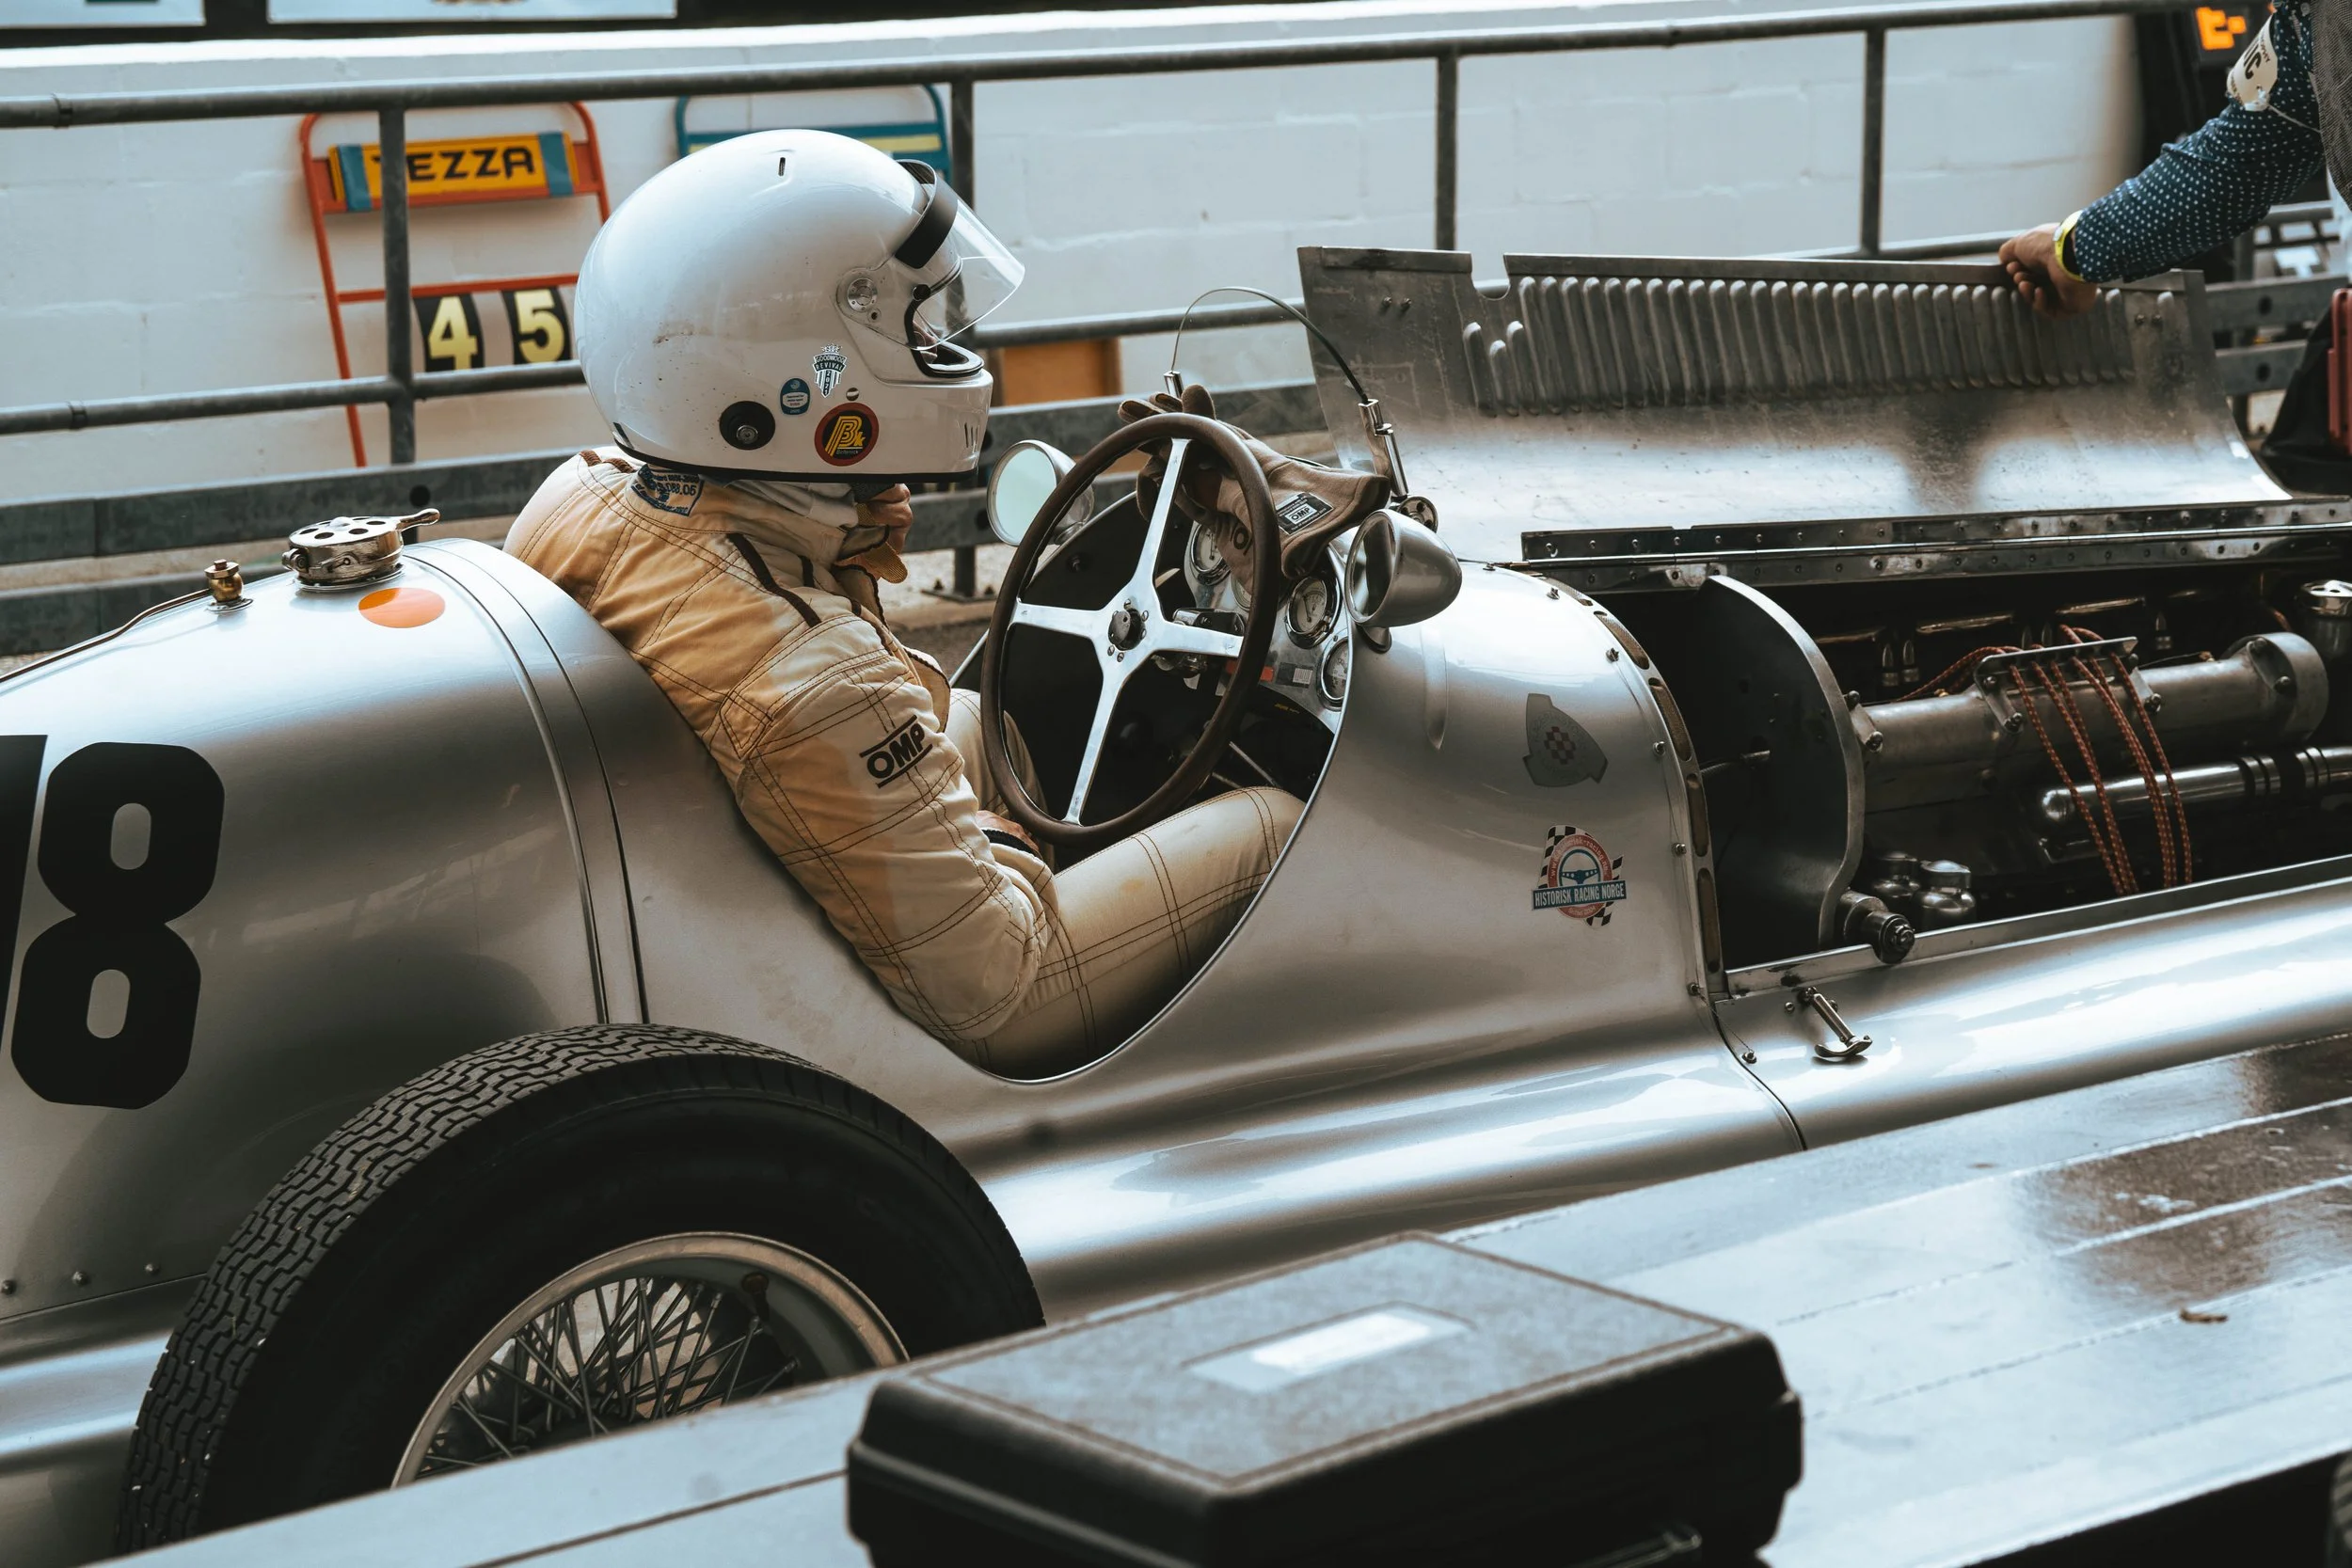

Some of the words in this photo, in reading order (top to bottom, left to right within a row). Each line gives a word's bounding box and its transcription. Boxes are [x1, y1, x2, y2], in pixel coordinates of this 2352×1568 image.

[371, 146, 535, 183] EZZA
[815, 361, 844, 372] REVIVAL
[816, 355, 845, 364] GOODWOOD
[1291, 507, 1311, 520] OMP
[866, 722, 926, 779] OMP
[1534, 888, 1572, 907] HISTORISK
[1574, 885, 1600, 902] RACING
[1601, 882, 1625, 899] NORGE
